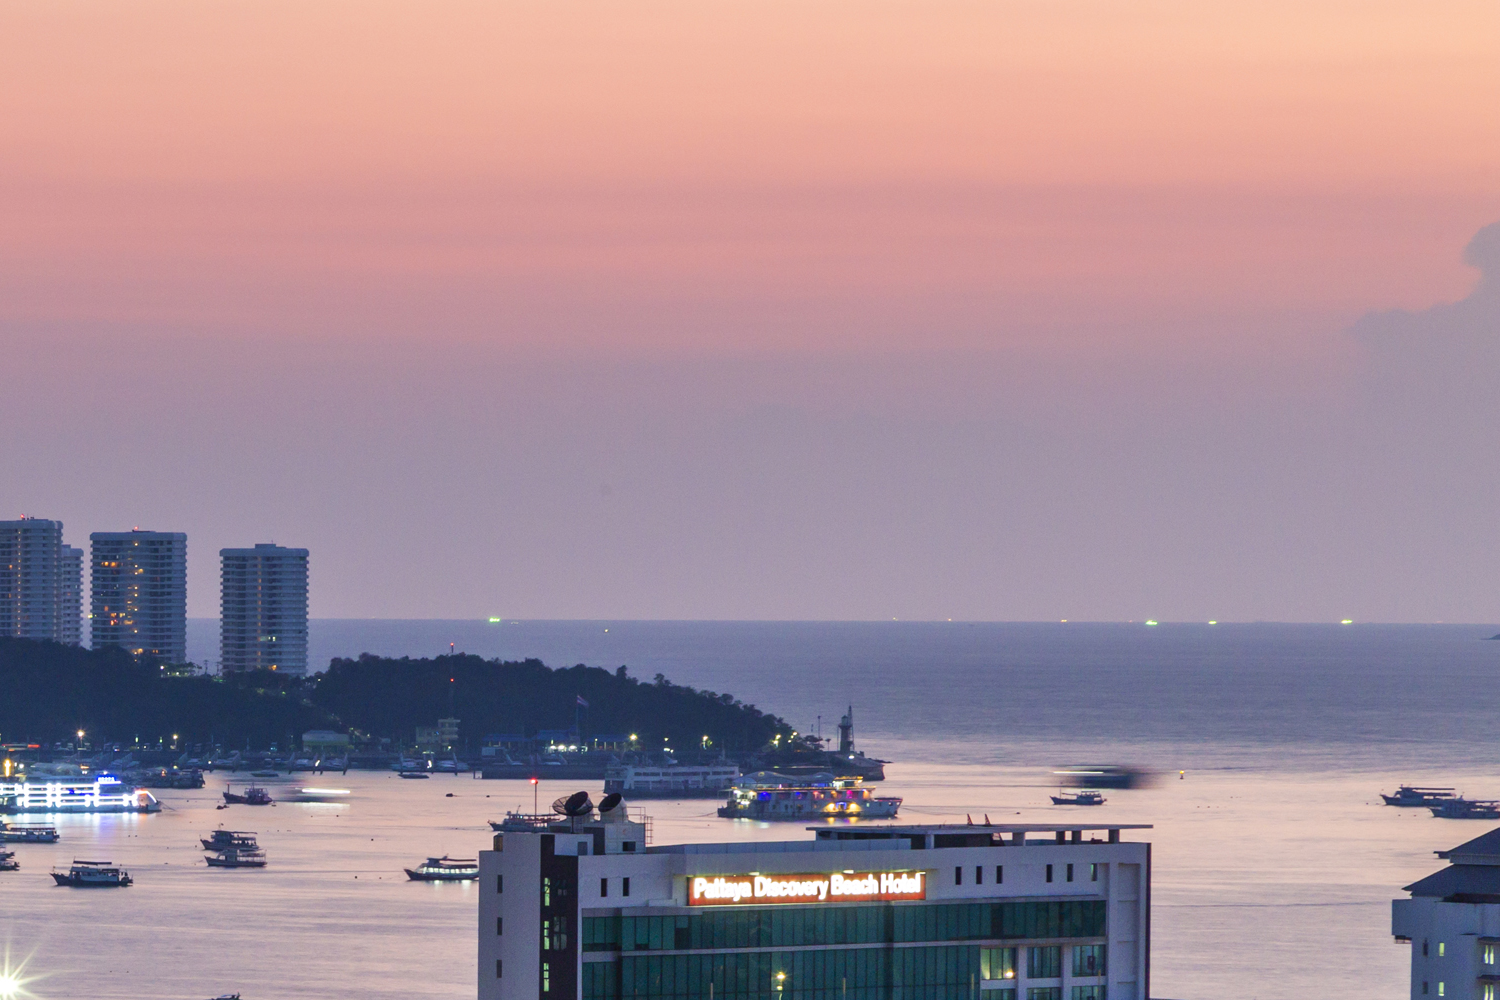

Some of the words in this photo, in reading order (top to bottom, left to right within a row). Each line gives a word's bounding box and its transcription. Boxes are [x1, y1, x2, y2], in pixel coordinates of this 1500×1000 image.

[694, 877, 752, 901] Pattaya
[754, 876, 828, 899] Discovery
[831, 874, 878, 895] Beach
[881, 872, 921, 894] Hotel
